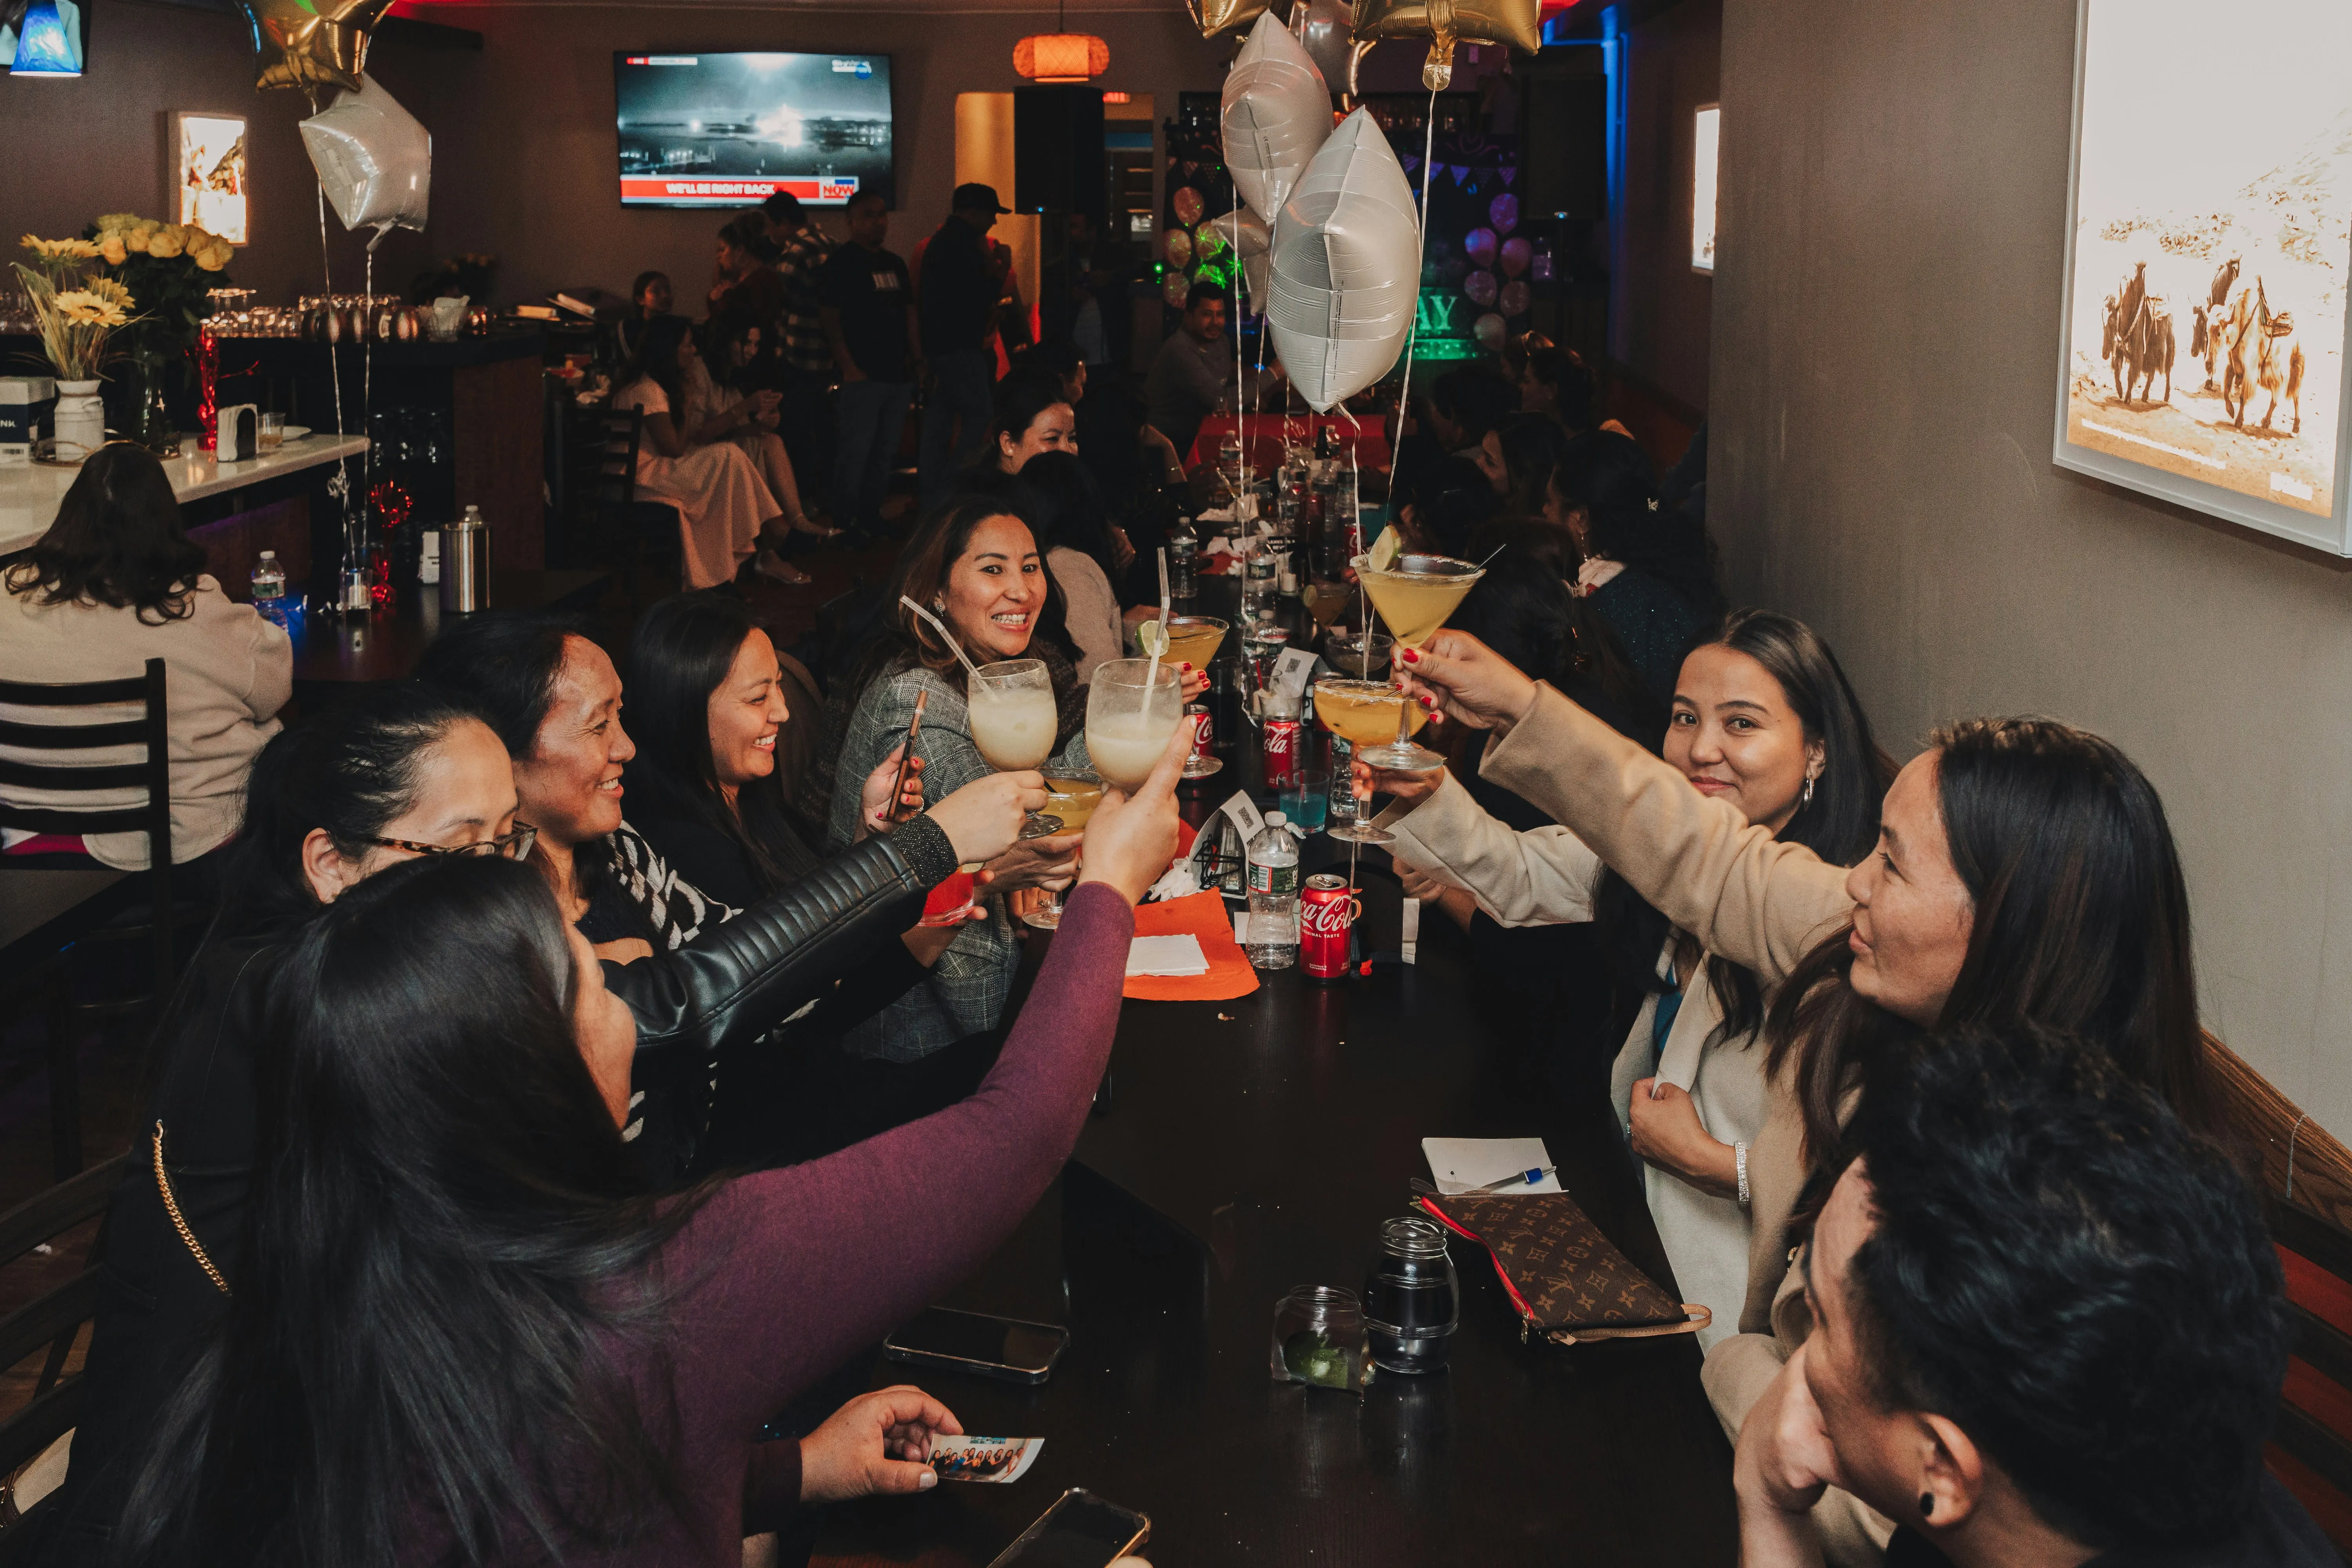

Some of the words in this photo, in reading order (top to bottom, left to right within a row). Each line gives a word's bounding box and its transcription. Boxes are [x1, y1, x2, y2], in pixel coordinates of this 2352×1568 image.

[712, 183, 743, 194] RIGHT
[744, 183, 775, 194] BACK
[824, 185, 854, 196] NOW
[1301, 928, 1322, 938] ORIGINAL
